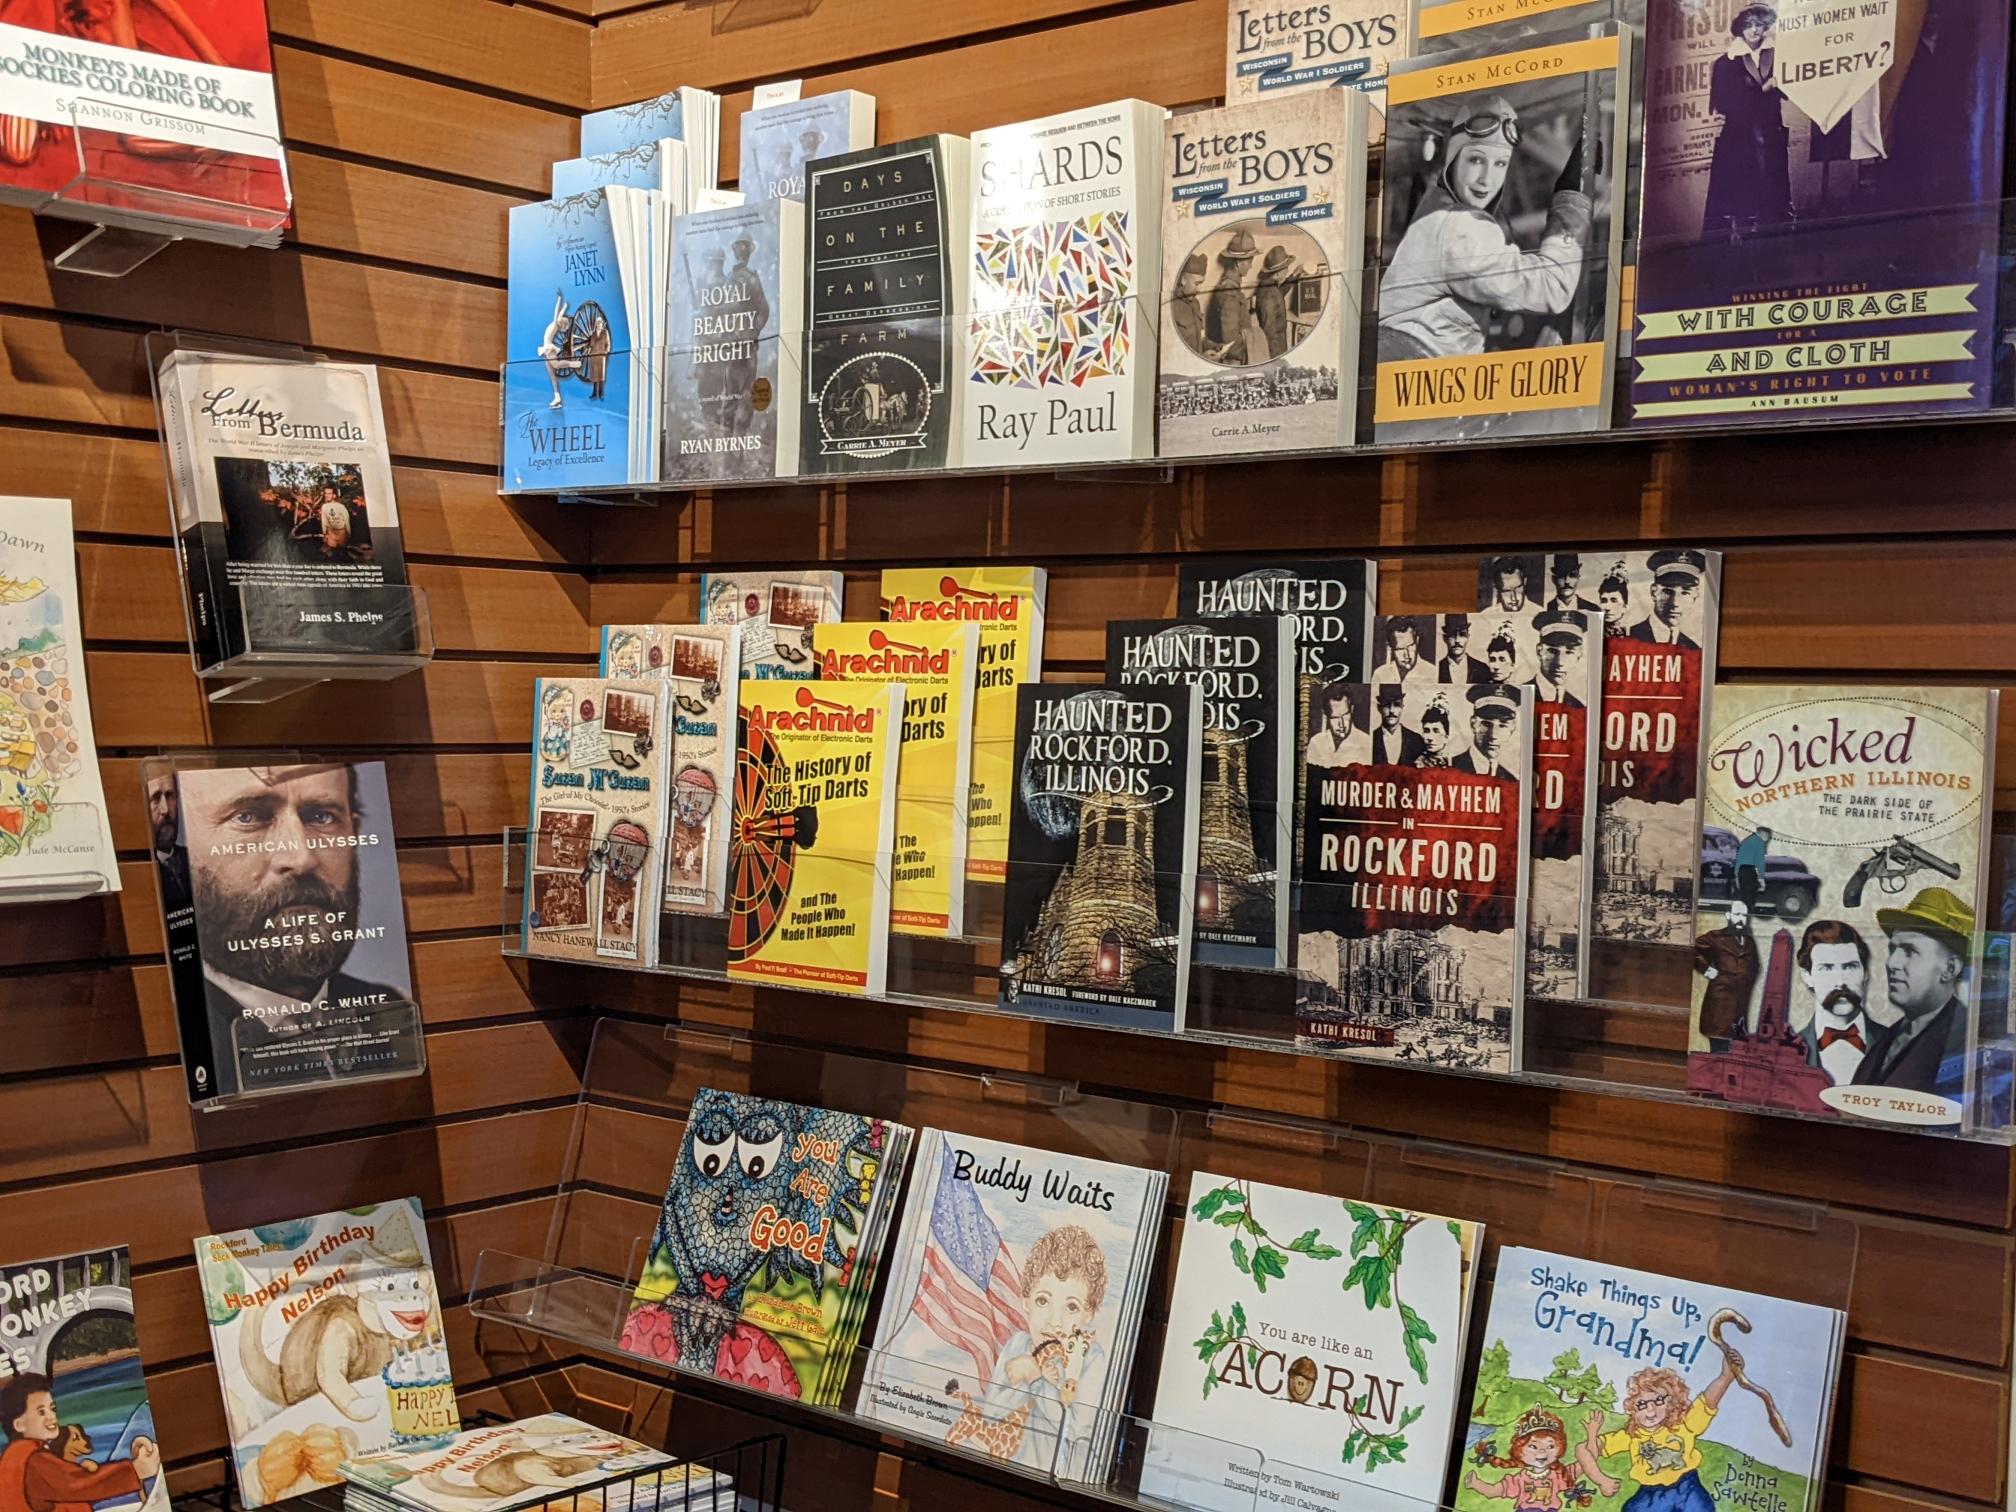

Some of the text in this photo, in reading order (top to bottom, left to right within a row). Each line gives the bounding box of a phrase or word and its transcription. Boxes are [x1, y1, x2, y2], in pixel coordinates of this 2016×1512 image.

[1236, 4, 1330, 54] Letters
[1778, 1, 1888, 33] MUST WOMEN WAIT
[1824, 32, 1854, 46] FOR
[22, 42, 221, 94] MONKEYS MADE OF
[1781, 41, 1891, 85] LIBERTY?
[86, 73, 195, 107] COLORING
[198, 93, 255, 119] BOOK
[1172, 130, 1266, 178] Letters
[1196, 142, 1333, 186] from the BOYS
[843, 171, 902, 193] DAYS
[1178, 182, 1224, 196] WISCONSIN
[1044, 186, 1121, 208] OF SHORT STORIES
[1199, 201, 1229, 212] WORLD
[1230, 197, 1250, 207] WAR
[1258, 190, 1300, 202] SOLDIERS
[1270, 208, 1326, 223] WRITE HOME
[826, 221, 924, 246] ON THE
[564, 250, 599, 273] JANET
[574, 266, 605, 288] LYNN
[827, 274, 924, 297] FAMILY
[701, 282, 751, 306] ROYAL
[1732, 283, 1868, 303] WINNING THE FIGHT
[693, 311, 757, 336] BEAUTY
[1677, 291, 1928, 333] WITH COURAGE
[840, 328, 907, 345] FARM
[1776, 329, 1817, 340] FOR A
[693, 340, 754, 365] BRIGHT
[1706, 340, 1890, 374] AND CLOTH
[1394, 355, 1588, 407] WINGS OF GLORY
[1669, 368, 1932, 397] WOMAN'S RIGHT TO VOTE
[1750, 395, 1840, 408] ANN BAUSUM
[212, 415, 365, 441] From Bermuda
[977, 391, 1117, 451] Ray Paul
[529, 424, 606, 454] WHEEL
[680, 435, 762, 454] RYAN BYRNES
[528, 452, 606, 471] Legacy of Excellence
[890, 595, 1018, 621] Arachnid
[1196, 578, 1347, 614] HAUNTED
[300, 612, 332, 623] James
[334, 612, 345, 623] S.
[822, 649, 949, 674] Arachnid
[1122, 634, 1261, 668] HAUNTED
[750, 705, 874, 733] Arachnid
[1033, 698, 1172, 733] HAUNTED
[781, 733, 811, 743] Originator
[821, 734, 854, 743] Electronic
[1711, 717, 1916, 788] Wicked
[766, 751, 872, 785] The History of
[1045, 764, 1150, 796] ILLINOIS
[765, 778, 868, 810] Soft-Tip Darts
[1321, 780, 1501, 814] MURDER & MAYHEM
[1736, 771, 1971, 812] NORTHERN ILLINOIS
[1824, 794, 1933, 809] THE DARK SIDE OF
[1403, 817, 1415, 830] IN
[1819, 806, 1935, 823] THE PRAIRIE STATE
[210, 834, 380, 857] AMERICAN ULYSSES
[1320, 834, 1497, 882] ROCKFORD
[800, 892, 837, 908] and The
[1352, 882, 1458, 916] ILLINOIS
[264, 912, 347, 929] A LIFE OF
[791, 908, 846, 925] People Who
[227, 927, 386, 952] ULYSSES S. GRANT
[532, 932, 561, 944] NANCY
[610, 940, 638, 953] STACY
[781, 924, 855, 941] Made It Happen!
[1023, 983, 1041, 994] KATHI
[1044, 986, 1067, 997] KRESOL
[243, 993, 388, 1020] RONALD C. WHITE
[1310, 1022, 1377, 1042] KATHI KRESOL
[1842, 1094, 1948, 1116] TROY TAYLOR
[953, 1149, 1115, 1212] Buddy Waits
[749, 1204, 831, 1264] Good
[223, 1224, 376, 1311] Happy Birthday
[280, 1265, 346, 1324] Nelson
[1531, 1266, 1702, 1329] Shake Things Up,
[1258, 1322, 1374, 1360] You are like an
[1535, 1290, 1707, 1374] Grandma!
[880, 1381, 948, 1410] By Elizabeth Brown
[1743, 1454, 1755, 1467] by
[1228, 1462, 1340, 1501] Written by Tom Wartowski
[1724, 1463, 1778, 1489] Donna
[1710, 1481, 1788, 1512] Sawtelle
